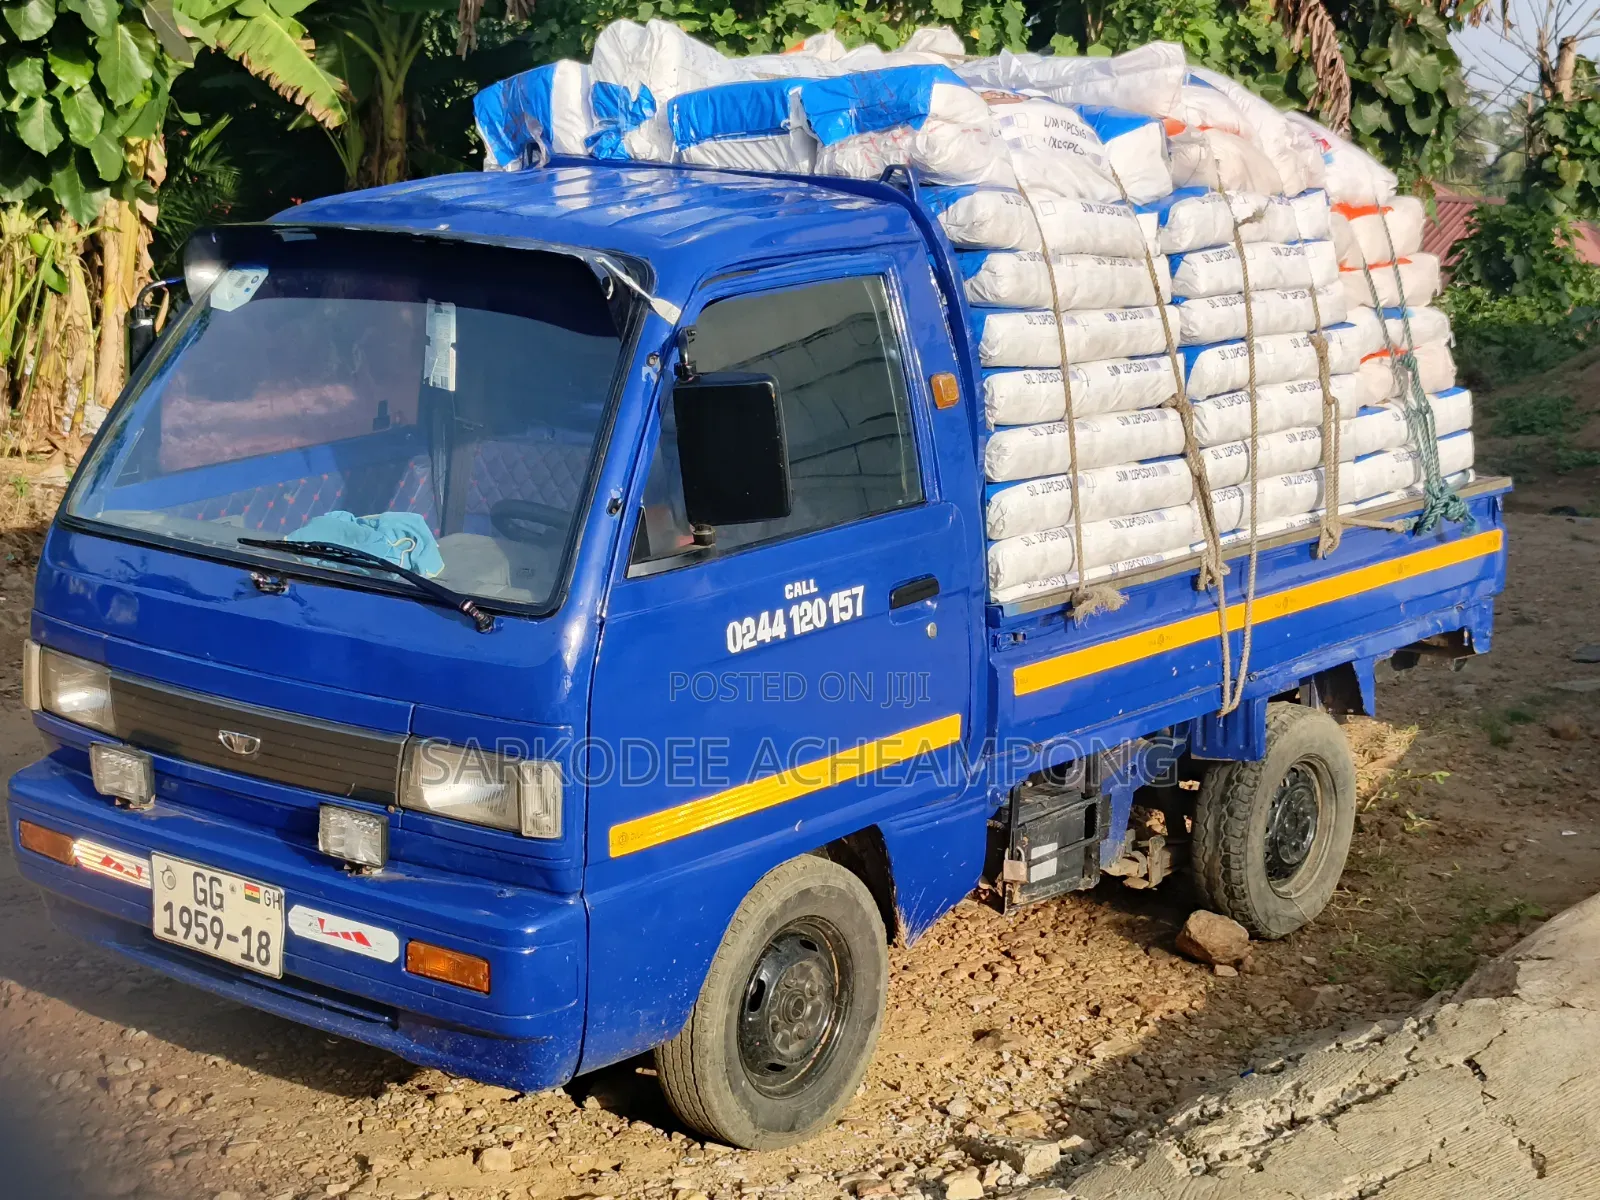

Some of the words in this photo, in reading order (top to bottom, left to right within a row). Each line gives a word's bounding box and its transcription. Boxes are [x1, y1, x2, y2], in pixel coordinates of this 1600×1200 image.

[785, 578, 818, 600] CALL
[726, 608, 787, 654] 0244
[789, 597, 828, 636] 120
[829, 585, 865, 624] 157
[193, 871, 225, 913] GG
[263, 889, 282, 911] GH
[163, 901, 271, 967] 1959-18
